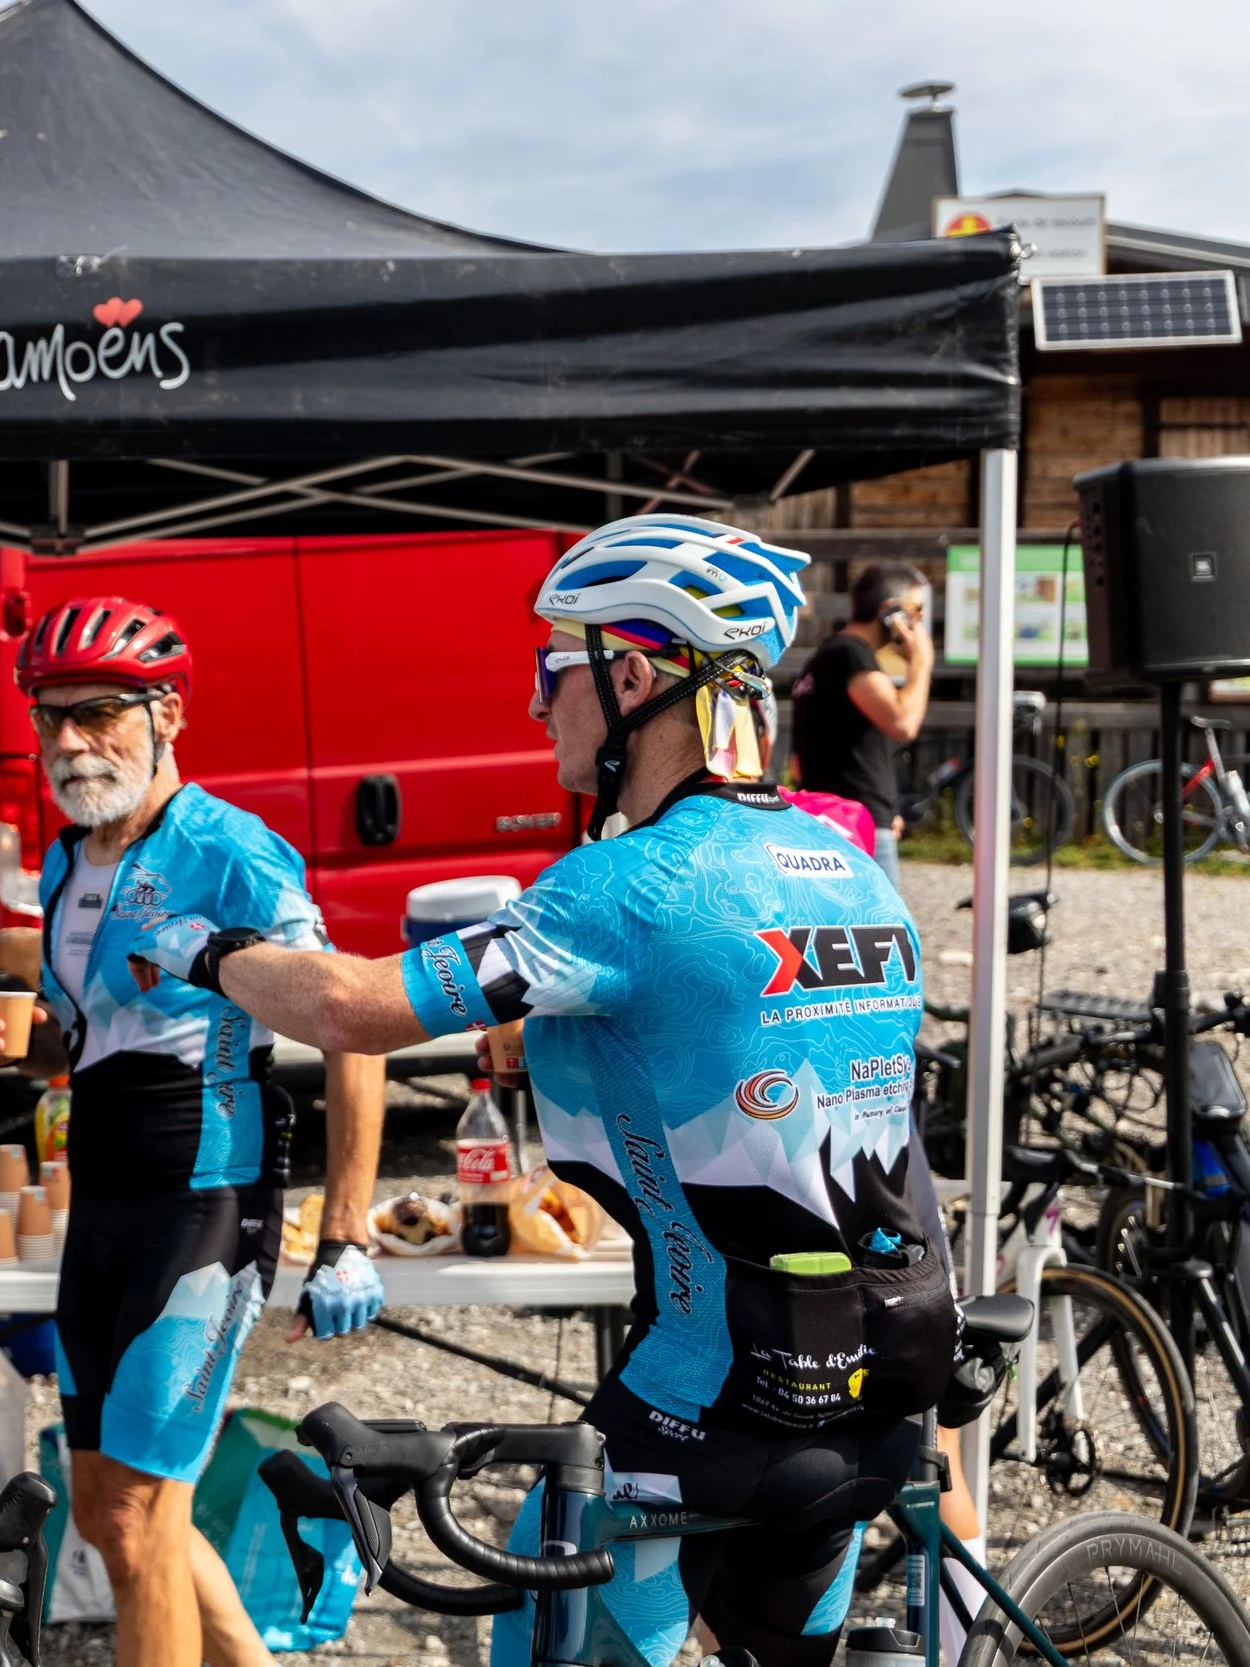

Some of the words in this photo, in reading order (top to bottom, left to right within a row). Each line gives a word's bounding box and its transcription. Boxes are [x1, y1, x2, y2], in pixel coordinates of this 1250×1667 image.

[775, 851, 846, 872] QUADRA
[753, 924, 917, 998] XEFI
[761, 1011, 781, 1025] LA
[786, 1001, 852, 1021] PROXIMITÉ
[817, 1095, 844, 1109] Nano
[846, 1085, 881, 1103] Plasma
[616, 1112, 675, 1212] Saint
[771, 1347, 821, 1371] Table
[763, 1368, 832, 1391] RESTAURANT
[778, 1387, 790, 1400] 04
[792, 1393, 804, 1405] 50
[805, 1395, 817, 1405] 36
[818, 1394, 829, 1404] 67
[648, 1409, 707, 1441] DIFFU
[629, 1510, 690, 1529] AXXOME
[1085, 1537, 1182, 1576] PRYMAHL
